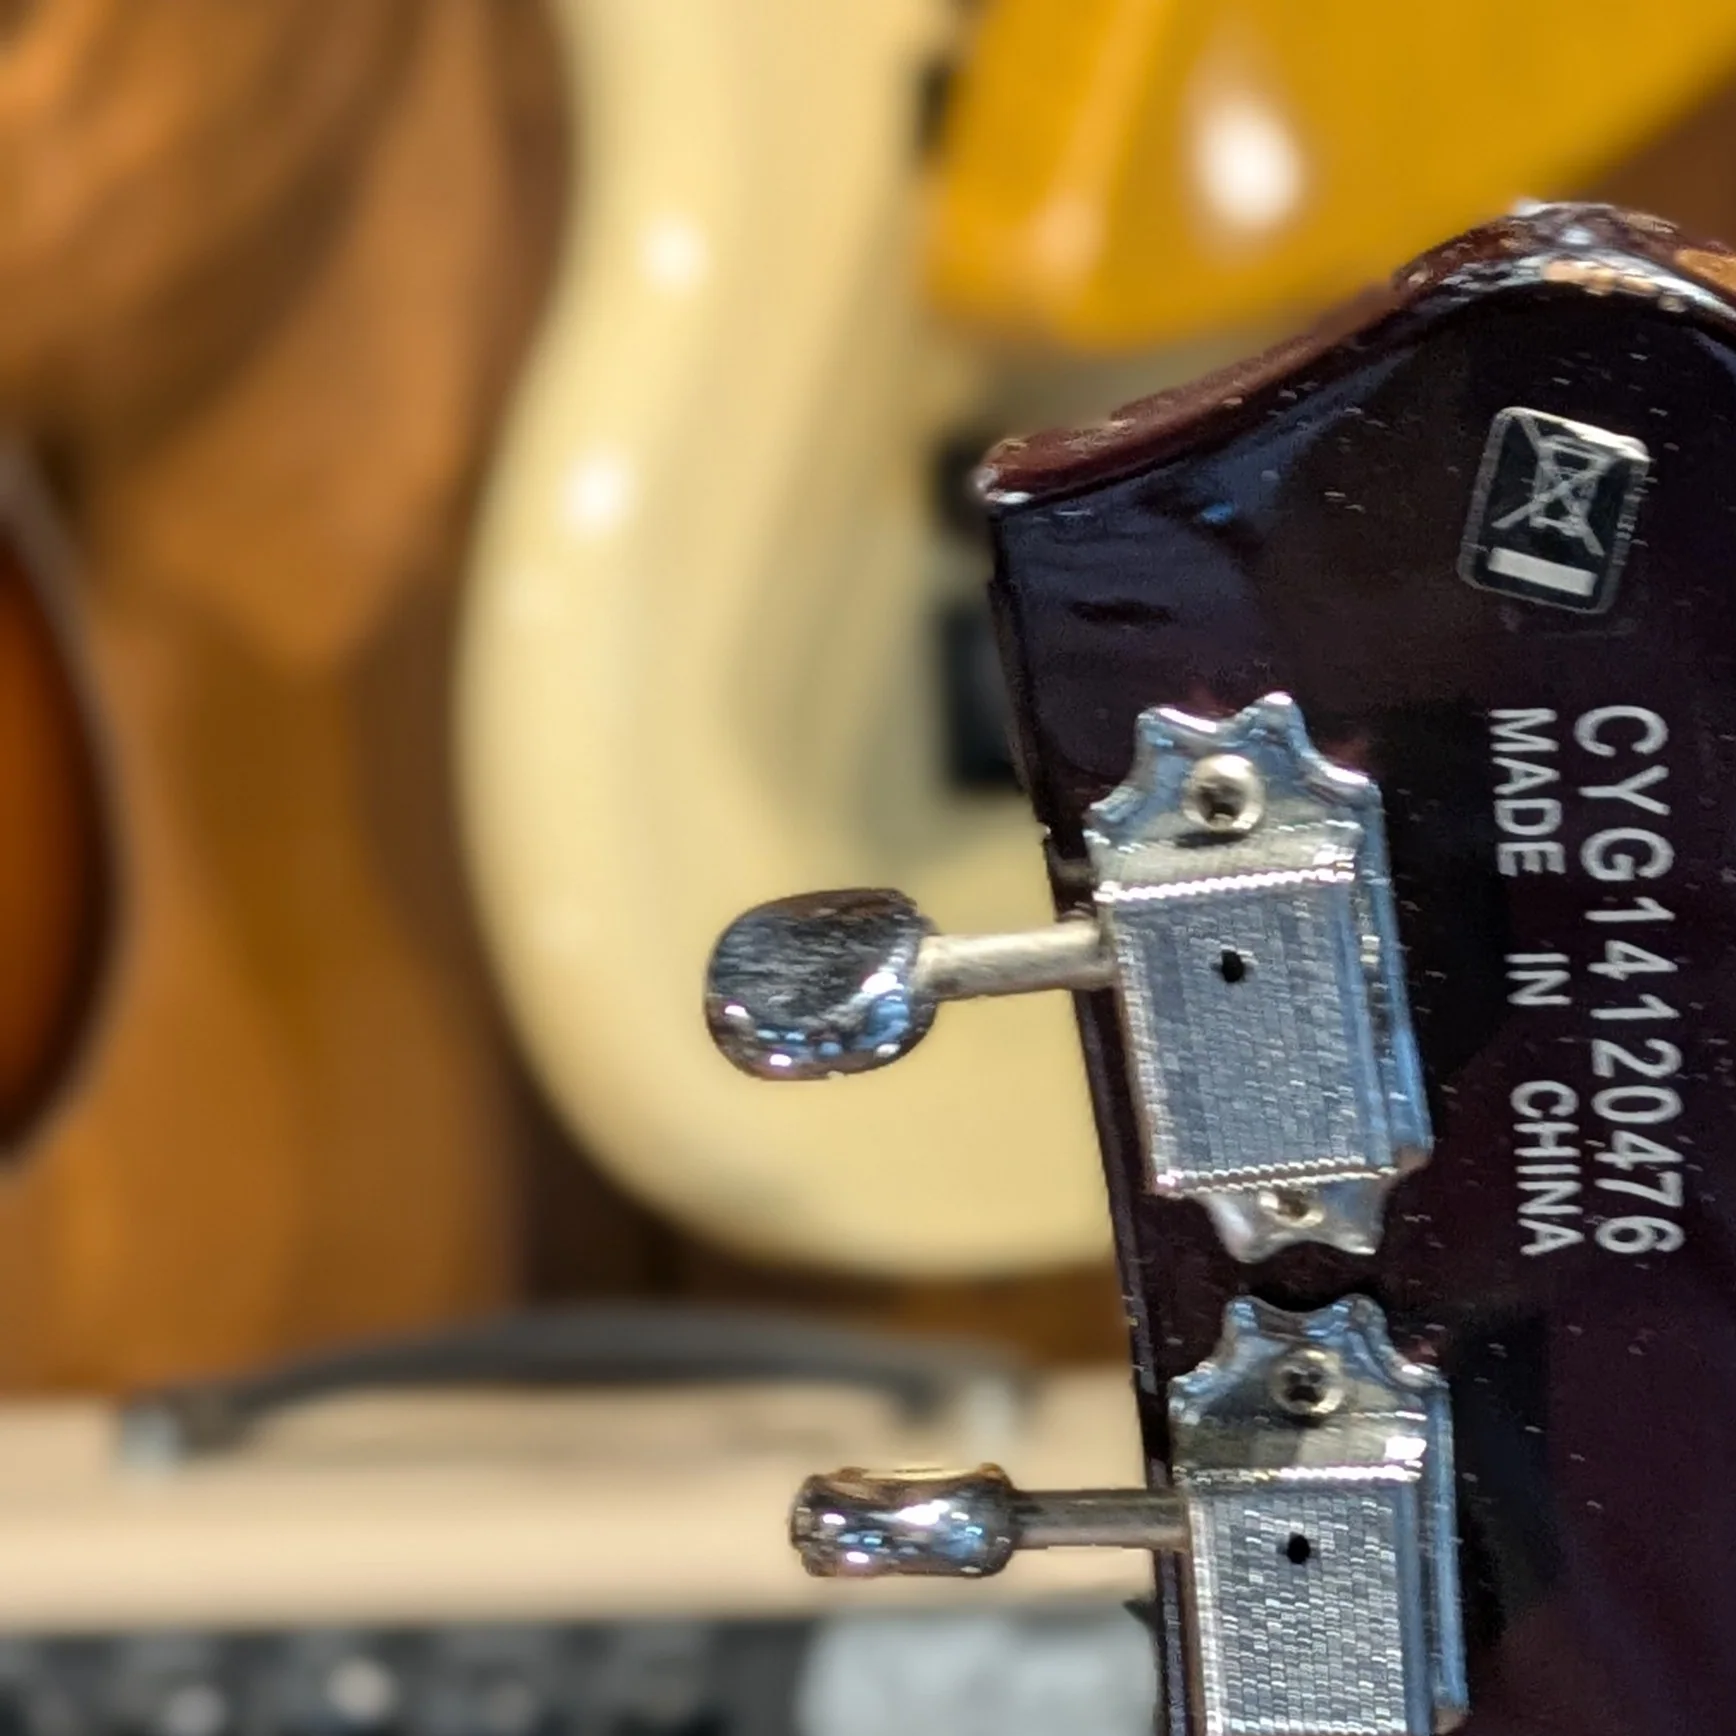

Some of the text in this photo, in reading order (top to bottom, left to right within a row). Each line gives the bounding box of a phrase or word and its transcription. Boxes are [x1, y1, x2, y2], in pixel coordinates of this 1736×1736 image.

[1490, 707, 1584, 1256] MADE IN CHINA
[1573, 705, 1685, 1254] CYG14120476
